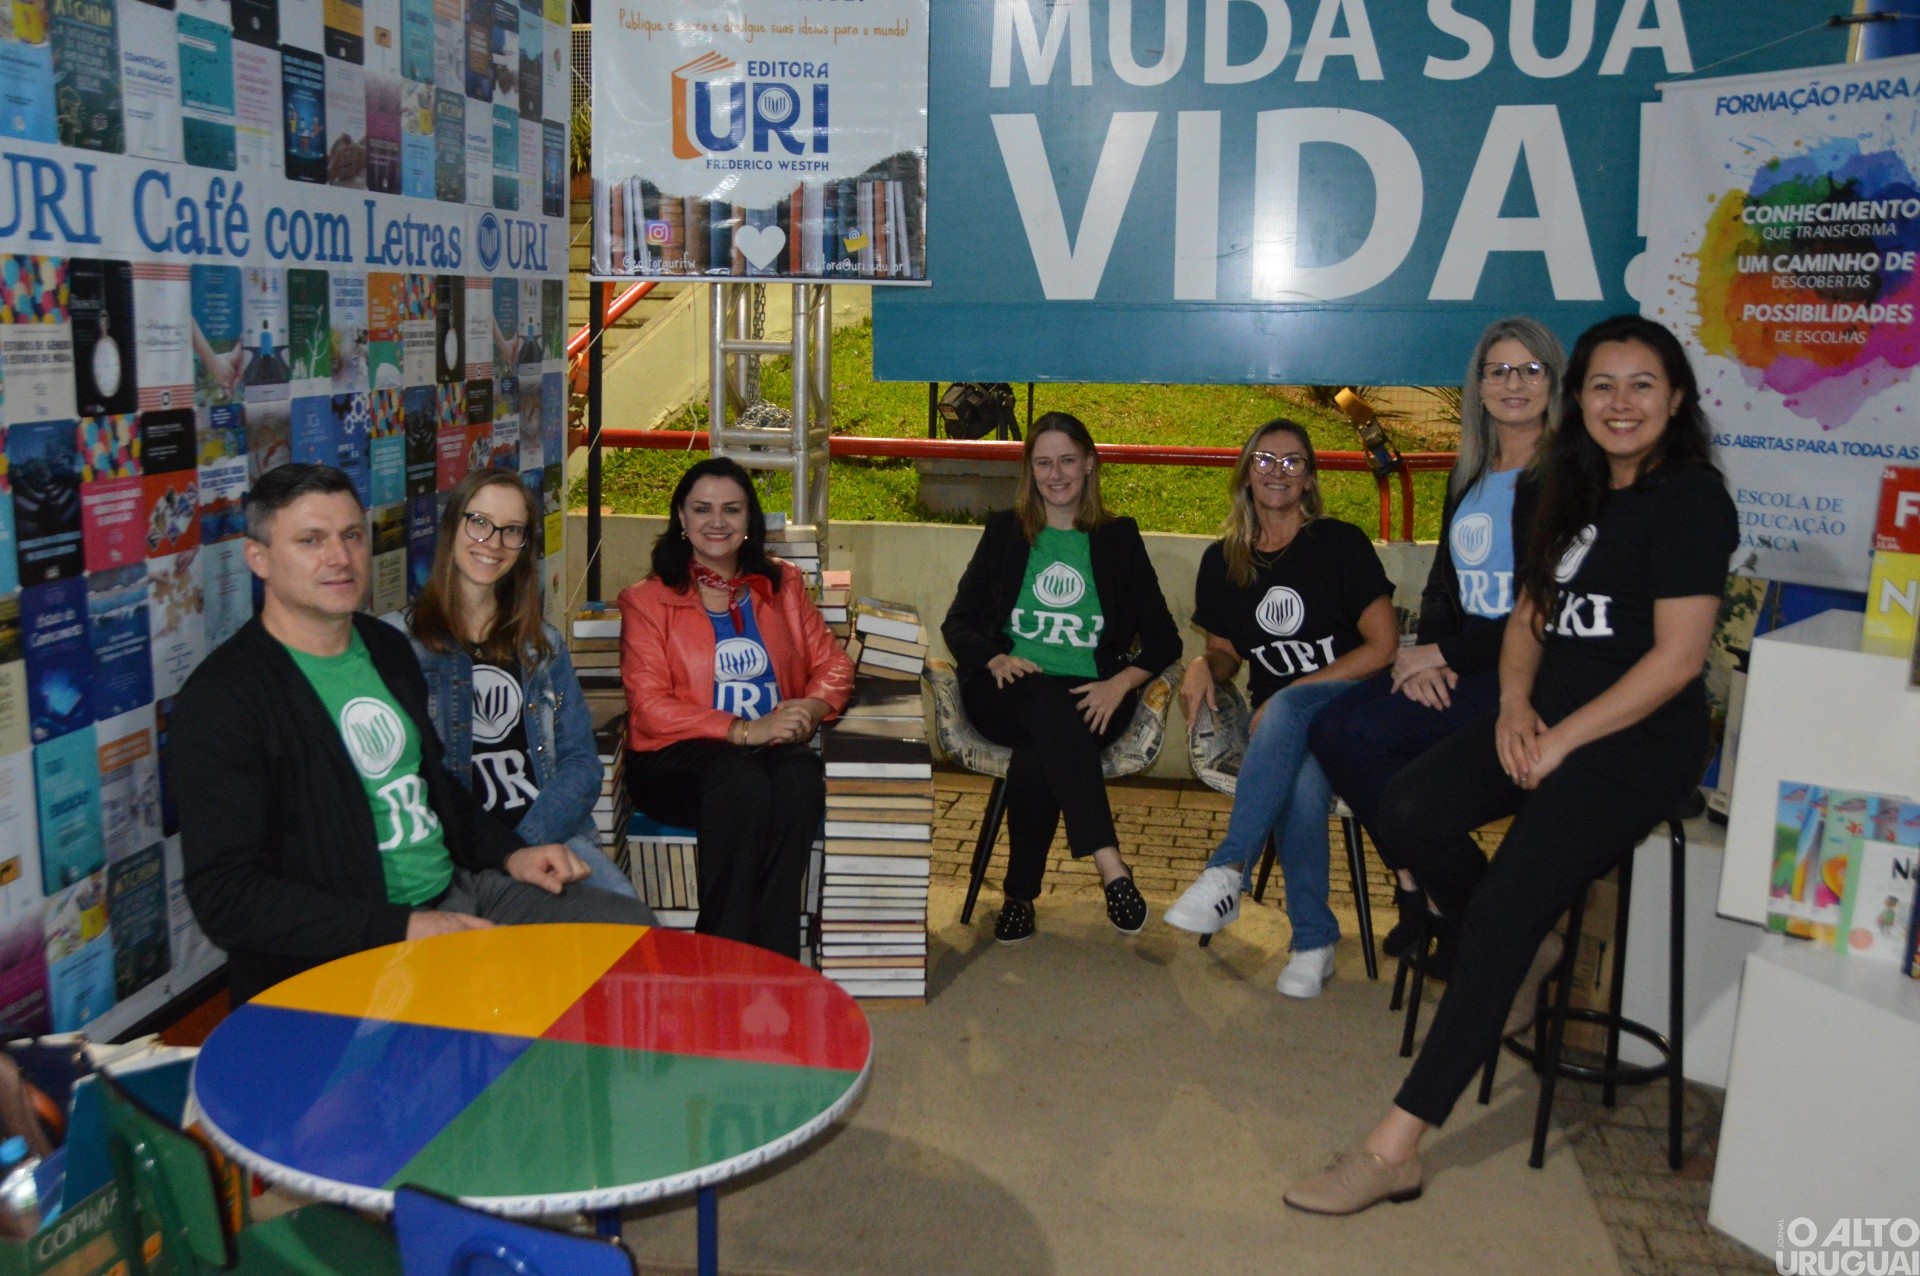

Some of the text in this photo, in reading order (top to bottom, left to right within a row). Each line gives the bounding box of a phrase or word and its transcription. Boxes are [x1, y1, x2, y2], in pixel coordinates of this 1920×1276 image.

[619, 8, 664, 41] Publique
[711, 22, 719, 32] e
[771, 24, 794, 34] suas
[799, 16, 828, 35] ideias
[834, 25, 858, 45] para
[863, 27, 869, 36] o
[873, 18, 908, 37] mundo!
[989, 0, 1694, 87] MUDA SUA
[747, 60, 829, 79] EDITORA
[1715, 80, 1841, 115] FORMAÇÃO
[1843, 77, 1909, 104] PARA
[695, 81, 829, 156] URI
[706, 159, 829, 172] FREDERICO WESTPH
[133, 169, 250, 258] Café
[265, 206, 353, 264] com
[364, 199, 462, 269] Letras
[504, 218, 548, 272] URI
[1741, 198, 1920, 225] CONHECIMENTO
[1762, 222, 1897, 240] QUE TRANSFORMA
[1737, 251, 1915, 274] UM CAMINHO DE
[1771, 274, 1872, 290] DESCOBERTAS
[1742, 303, 1914, 323] POSSIBILIDADES
[1774, 329, 1867, 344] DE ESCOLHAS
[1735, 434, 1794, 452] ABERTAS
[1796, 438, 1838, 455] PARA
[1842, 441, 1894, 459] TODAS
[1897, 445, 1920, 460] AS
[1737, 488, 1844, 513] ESCOLA DE
[1894, 490, 1920, 527] F
[1737, 510, 1846, 536] EDUCAÇÃO
[1011, 607, 1105, 648] URI
